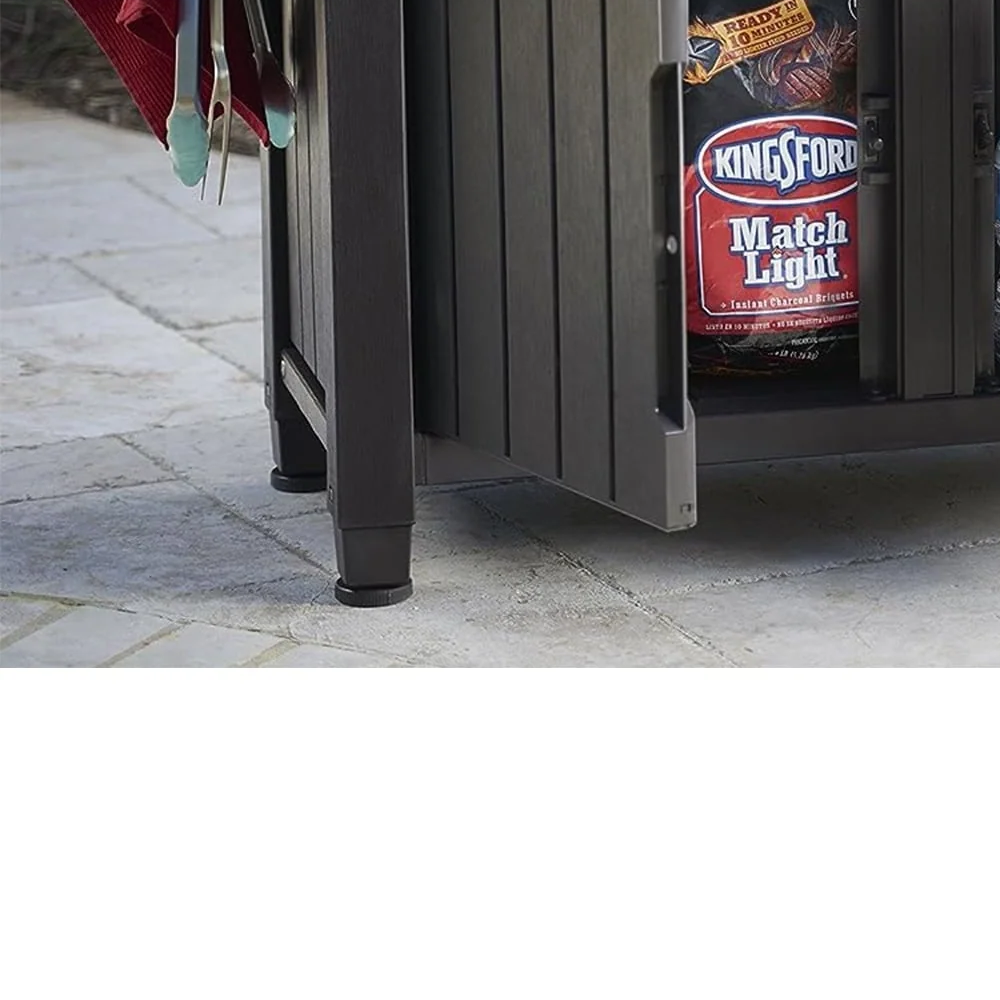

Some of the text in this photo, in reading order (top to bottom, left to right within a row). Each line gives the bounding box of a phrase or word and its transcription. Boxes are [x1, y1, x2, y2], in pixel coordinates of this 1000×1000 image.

[723, 0, 798, 35] READY IN
[729, 12, 805, 49] 10 MINUTES
[715, 131, 858, 189] KINGSFORD
[729, 212, 848, 252] Match
[743, 246, 839, 289] Light
[731, 291, 855, 310] Instant Charcoal Briquets
